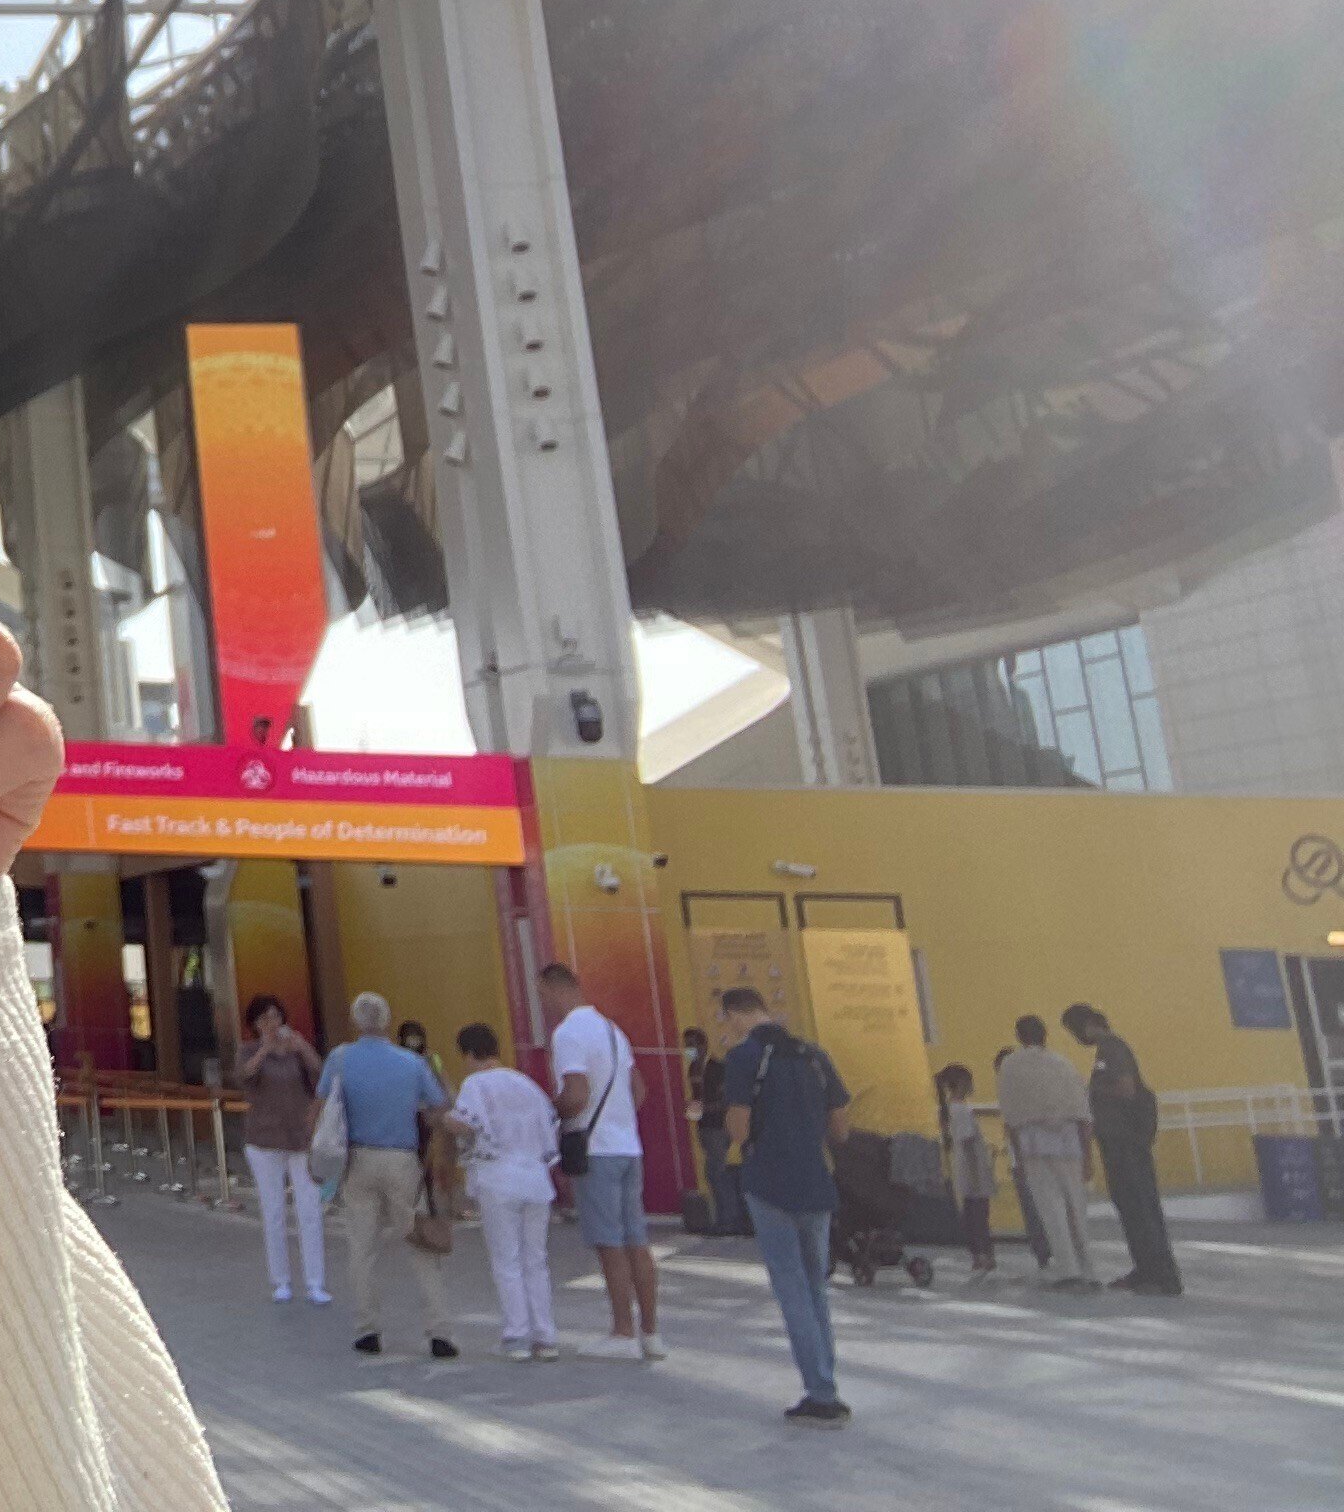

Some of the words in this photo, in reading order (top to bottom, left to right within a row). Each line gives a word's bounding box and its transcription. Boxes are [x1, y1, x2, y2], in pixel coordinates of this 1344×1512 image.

[102, 761, 184, 780] Fireworks
[291, 766, 380, 787] Hazardous
[382, 769, 453, 788] Material
[107, 814, 151, 833] Fast
[156, 815, 210, 836] Track
[215, 818, 231, 836] &
[235, 818, 307, 842] People
[311, 819, 333, 839] of
[337, 821, 487, 844] Determination
